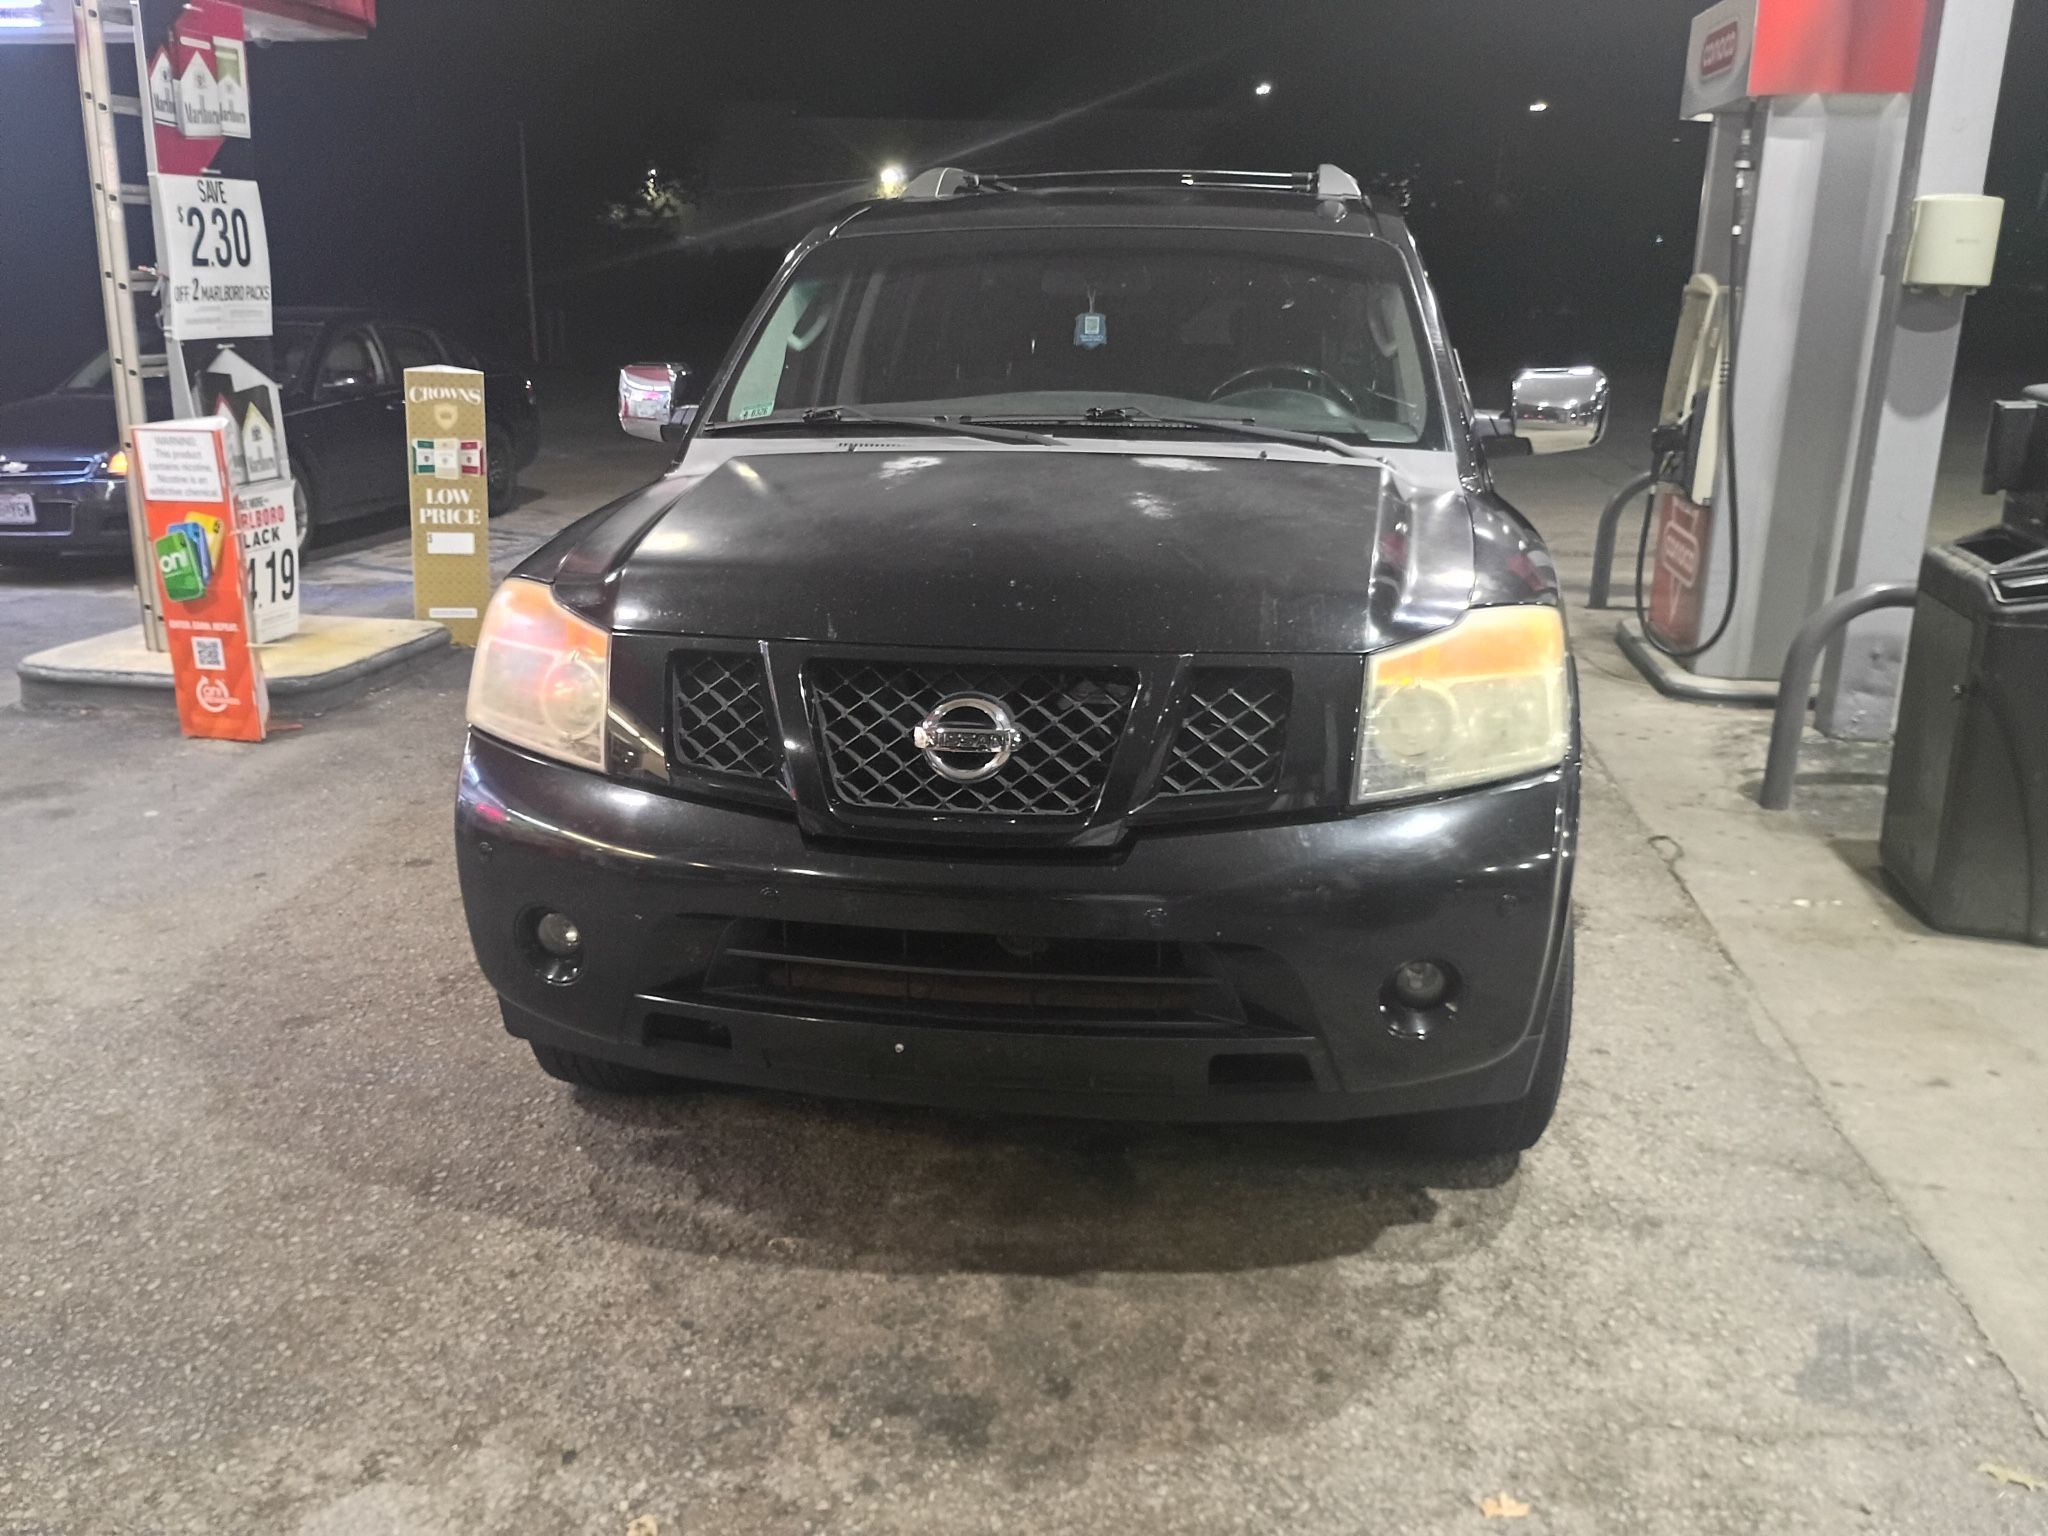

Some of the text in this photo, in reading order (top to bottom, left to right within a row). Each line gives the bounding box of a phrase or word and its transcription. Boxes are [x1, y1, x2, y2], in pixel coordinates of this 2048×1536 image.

[197, 180, 227, 204] SAVE
[174, 278, 270, 302] OFF 2 MARLBORO PACKS
[409, 386, 481, 406] CROWNS
[425, 488, 472, 505] LOW
[419, 508, 481, 525] PRICE
[242, 526, 281, 548] LACK
